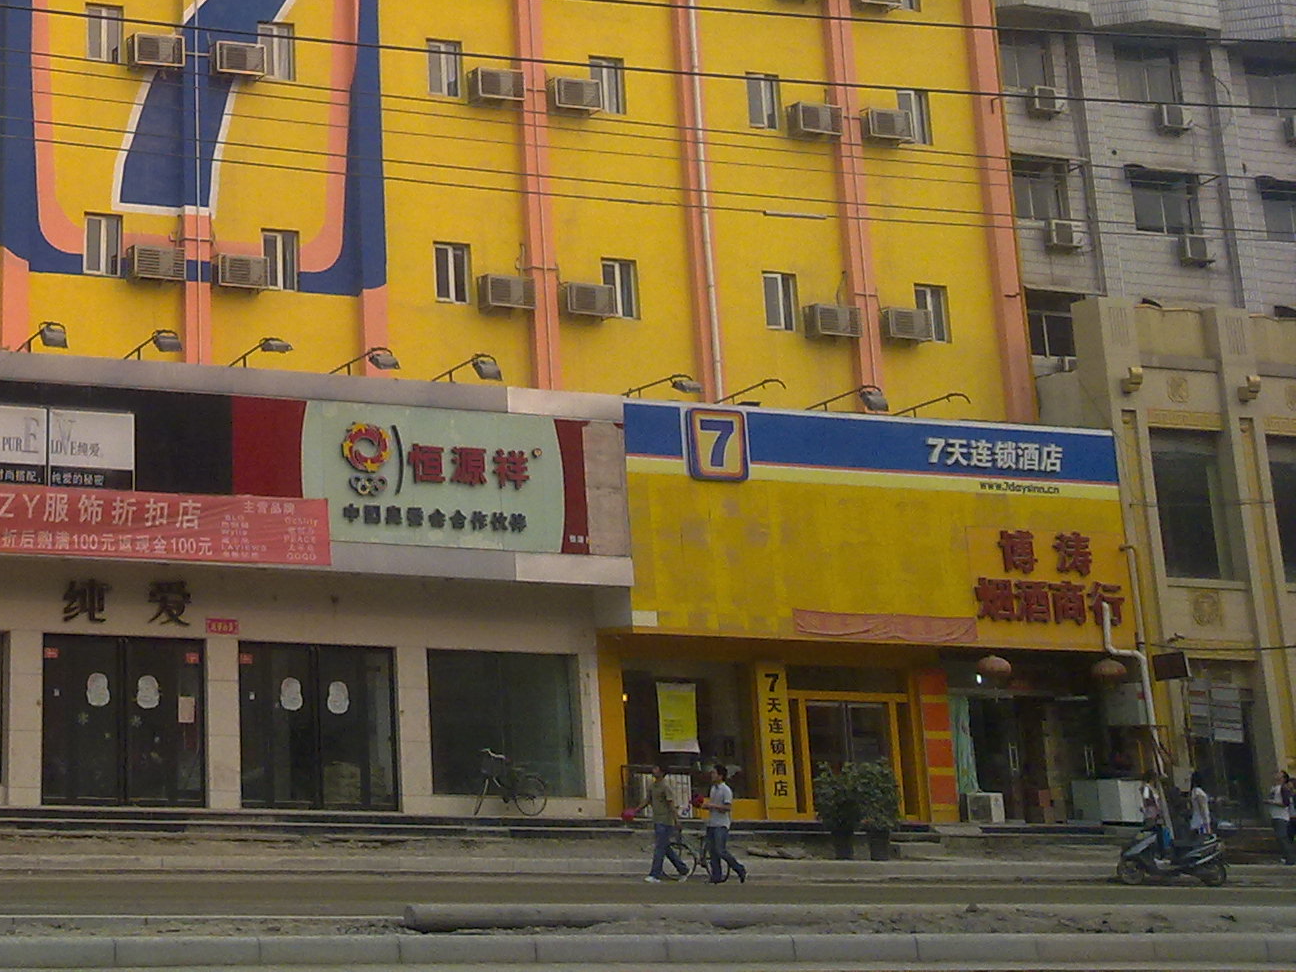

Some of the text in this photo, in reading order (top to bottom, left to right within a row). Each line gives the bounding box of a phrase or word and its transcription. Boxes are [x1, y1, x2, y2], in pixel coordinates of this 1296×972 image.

[407, 443, 530, 489] 恒源祥
[699, 418, 735, 468] 7
[926, 437, 1064, 472] 7天连锁酒店
[979, 481, 1061, 495] www.7daysinn.cn
[998, 529, 1093, 576] 博涛
[62, 577, 192, 626] 纯爱
[974, 577, 1125, 626] 烟酒商行
[764, 673, 788, 797] 7天连锁酒店
